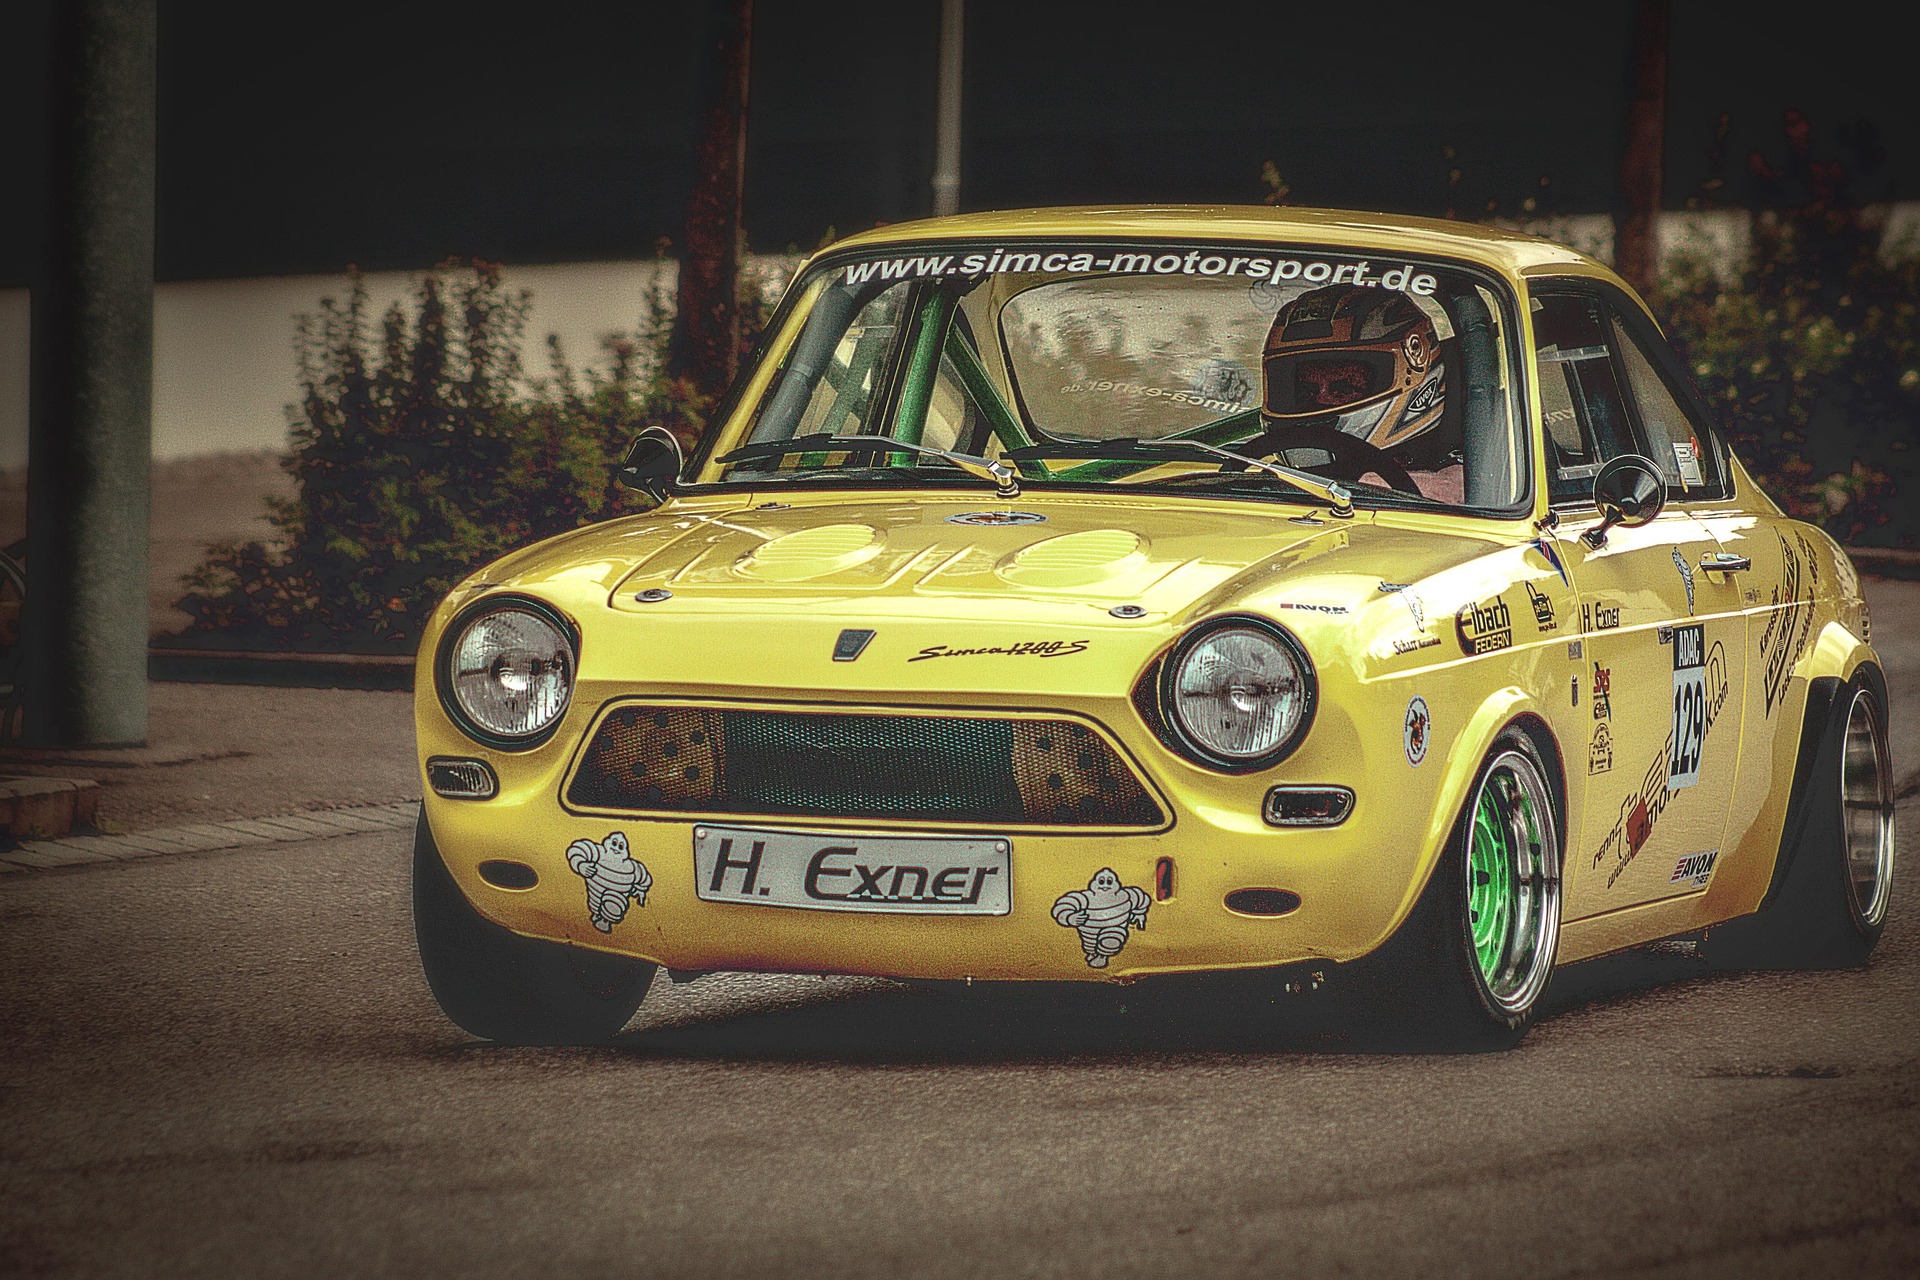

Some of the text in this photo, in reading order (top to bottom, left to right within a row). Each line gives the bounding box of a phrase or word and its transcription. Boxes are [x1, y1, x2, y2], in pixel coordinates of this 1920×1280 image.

[846, 248, 1438, 296] www.simca-motorsport.de
[1455, 595, 1511, 658] Eibach
[1582, 603, 1593, 633] H.
[1595, 601, 1620, 631] Exner
[1476, 631, 1510, 654] FEDERN
[1678, 627, 1700, 667] ADAC
[1670, 680, 1704, 777] 129
[709, 837, 1000, 905] H. Exner
[1680, 851, 1719, 878] AVON
